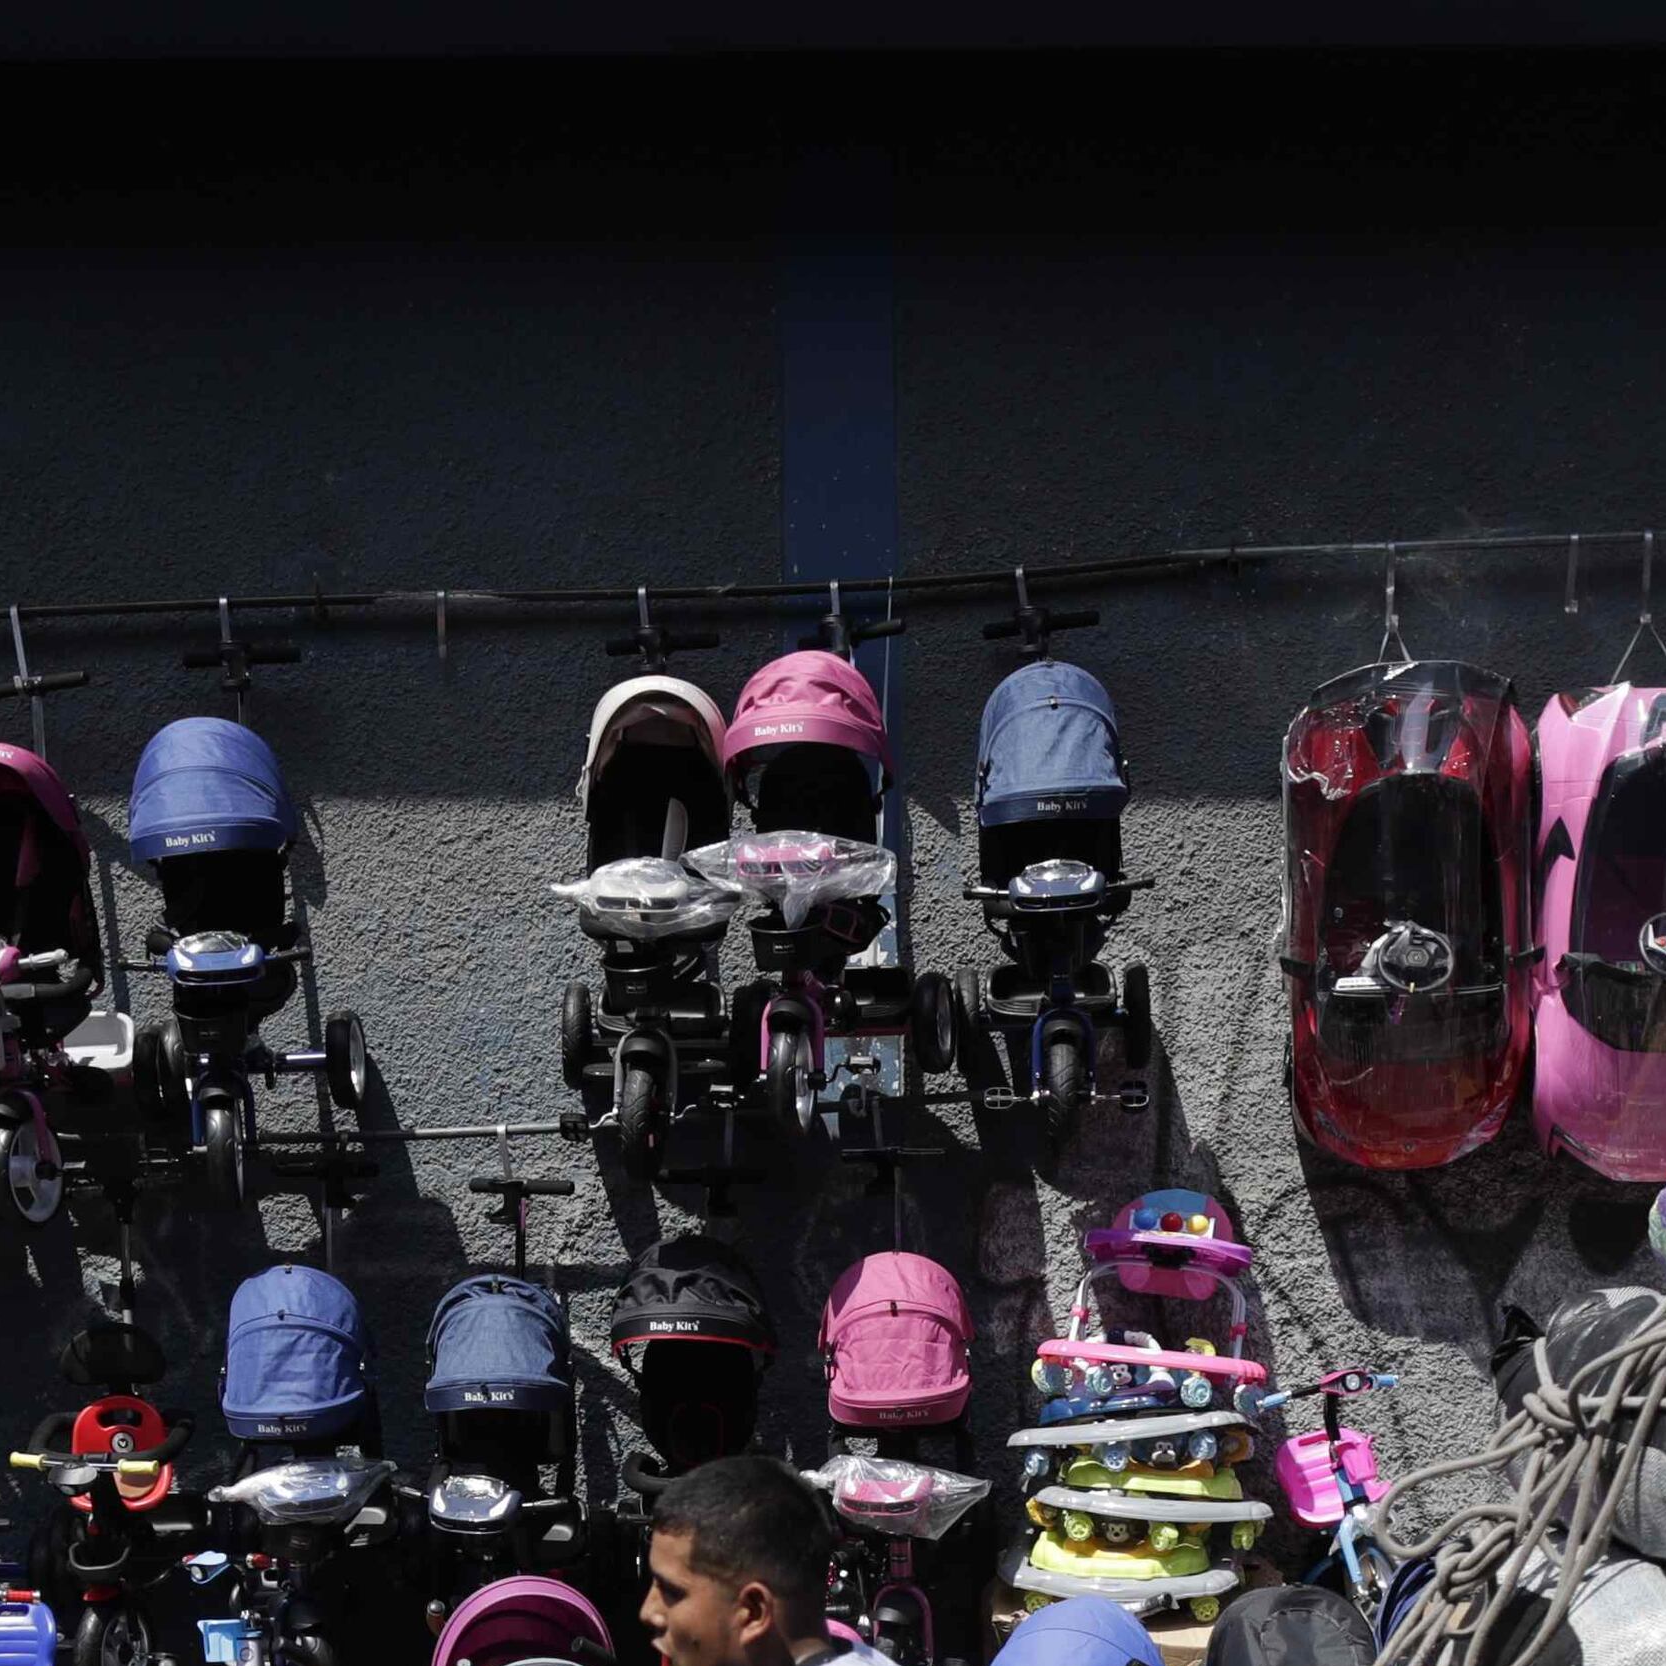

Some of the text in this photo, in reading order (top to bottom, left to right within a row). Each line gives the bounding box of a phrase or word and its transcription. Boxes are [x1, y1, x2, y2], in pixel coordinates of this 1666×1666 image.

[754, 721, 804, 737] Baby Kit's
[1037, 801, 1062, 813] Baby
[165, 830, 216, 847] Baby Kit's
[649, 1320, 700, 1332] Baby Kit's
[464, 1389, 515, 1403] Baby Kit's
[258, 1424, 282, 1435] Baby
